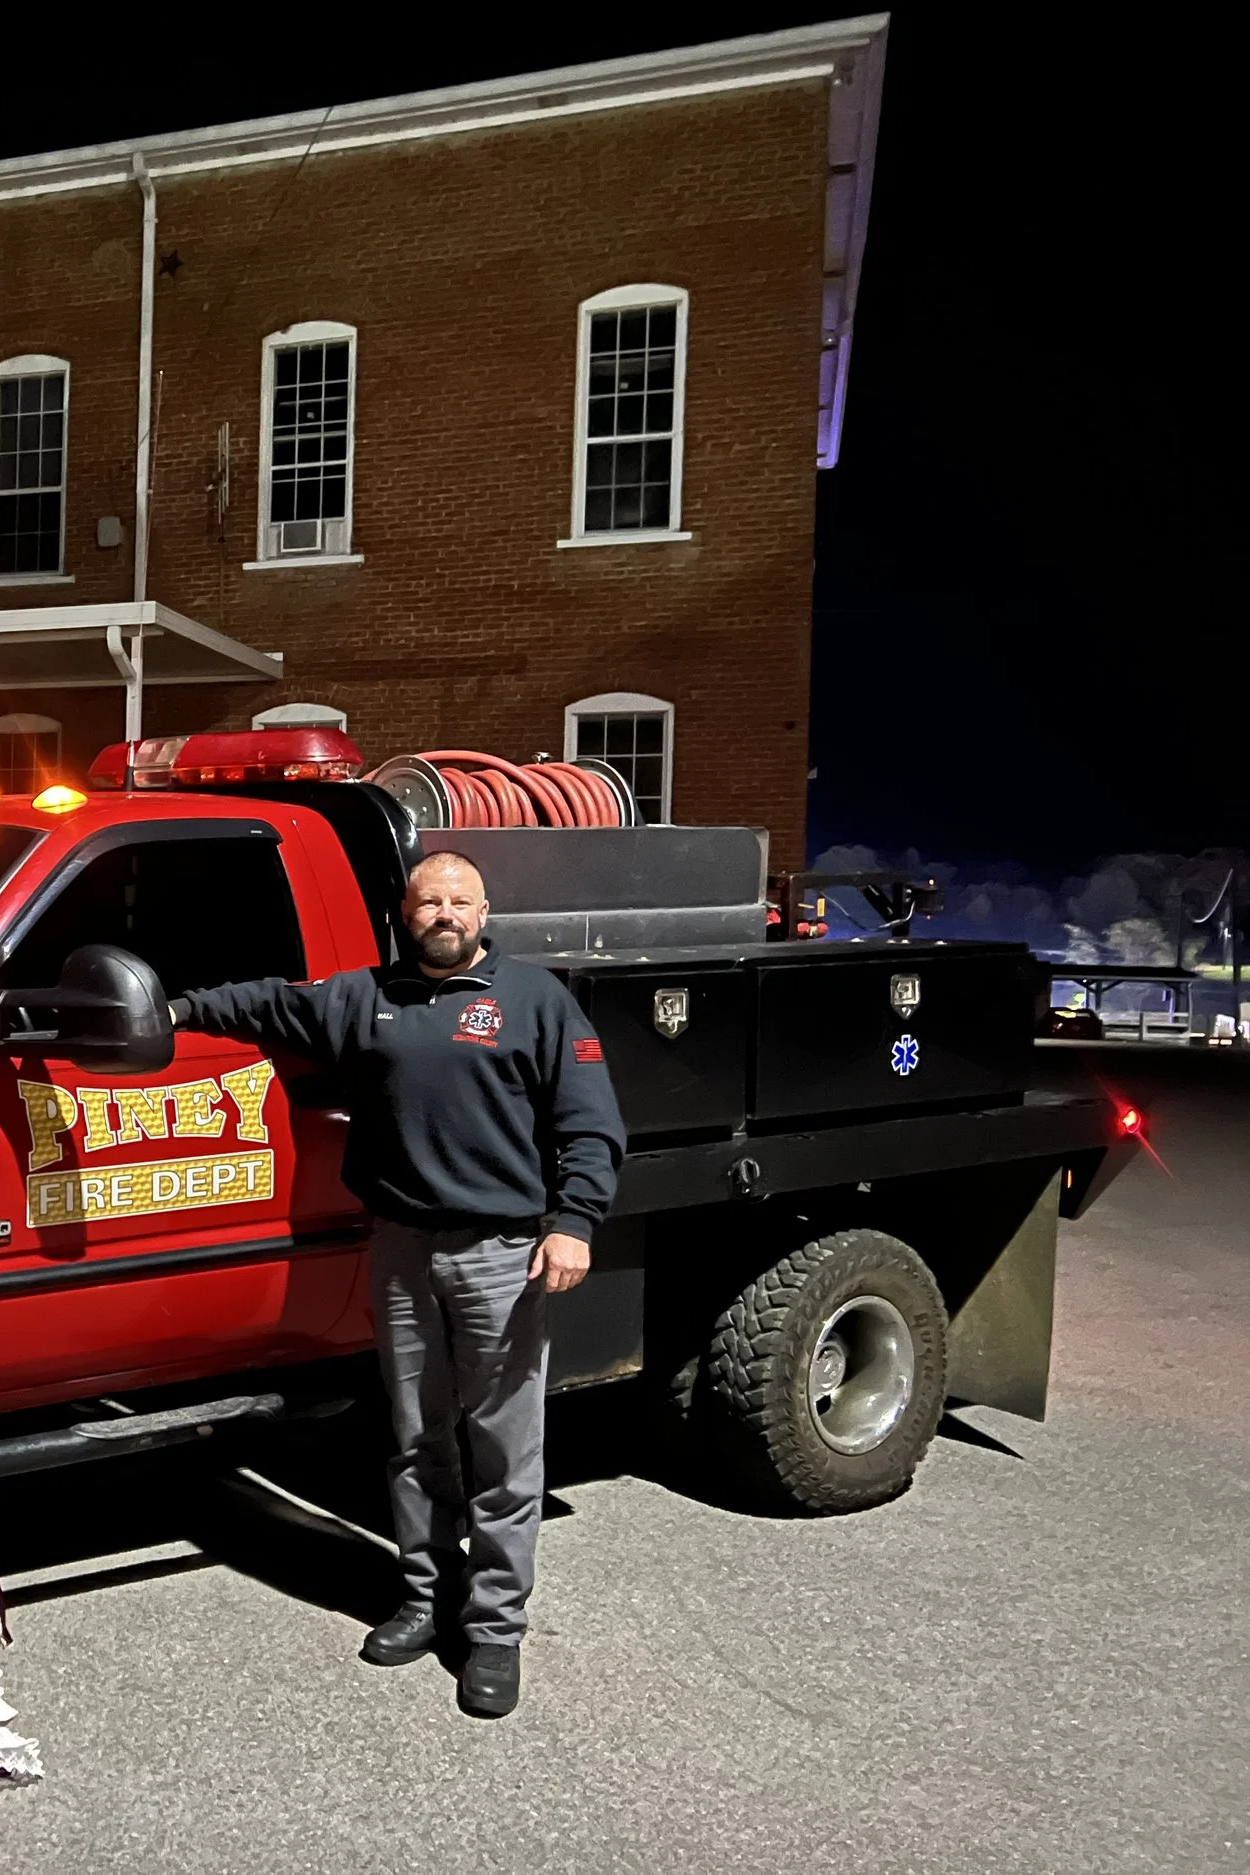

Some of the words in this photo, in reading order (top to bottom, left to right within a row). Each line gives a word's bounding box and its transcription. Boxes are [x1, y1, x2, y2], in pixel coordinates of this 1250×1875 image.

[17, 1059, 275, 1171] PINEY
[38, 1174, 133, 1216] FIRE
[151, 1159, 263, 1203] DEPT
